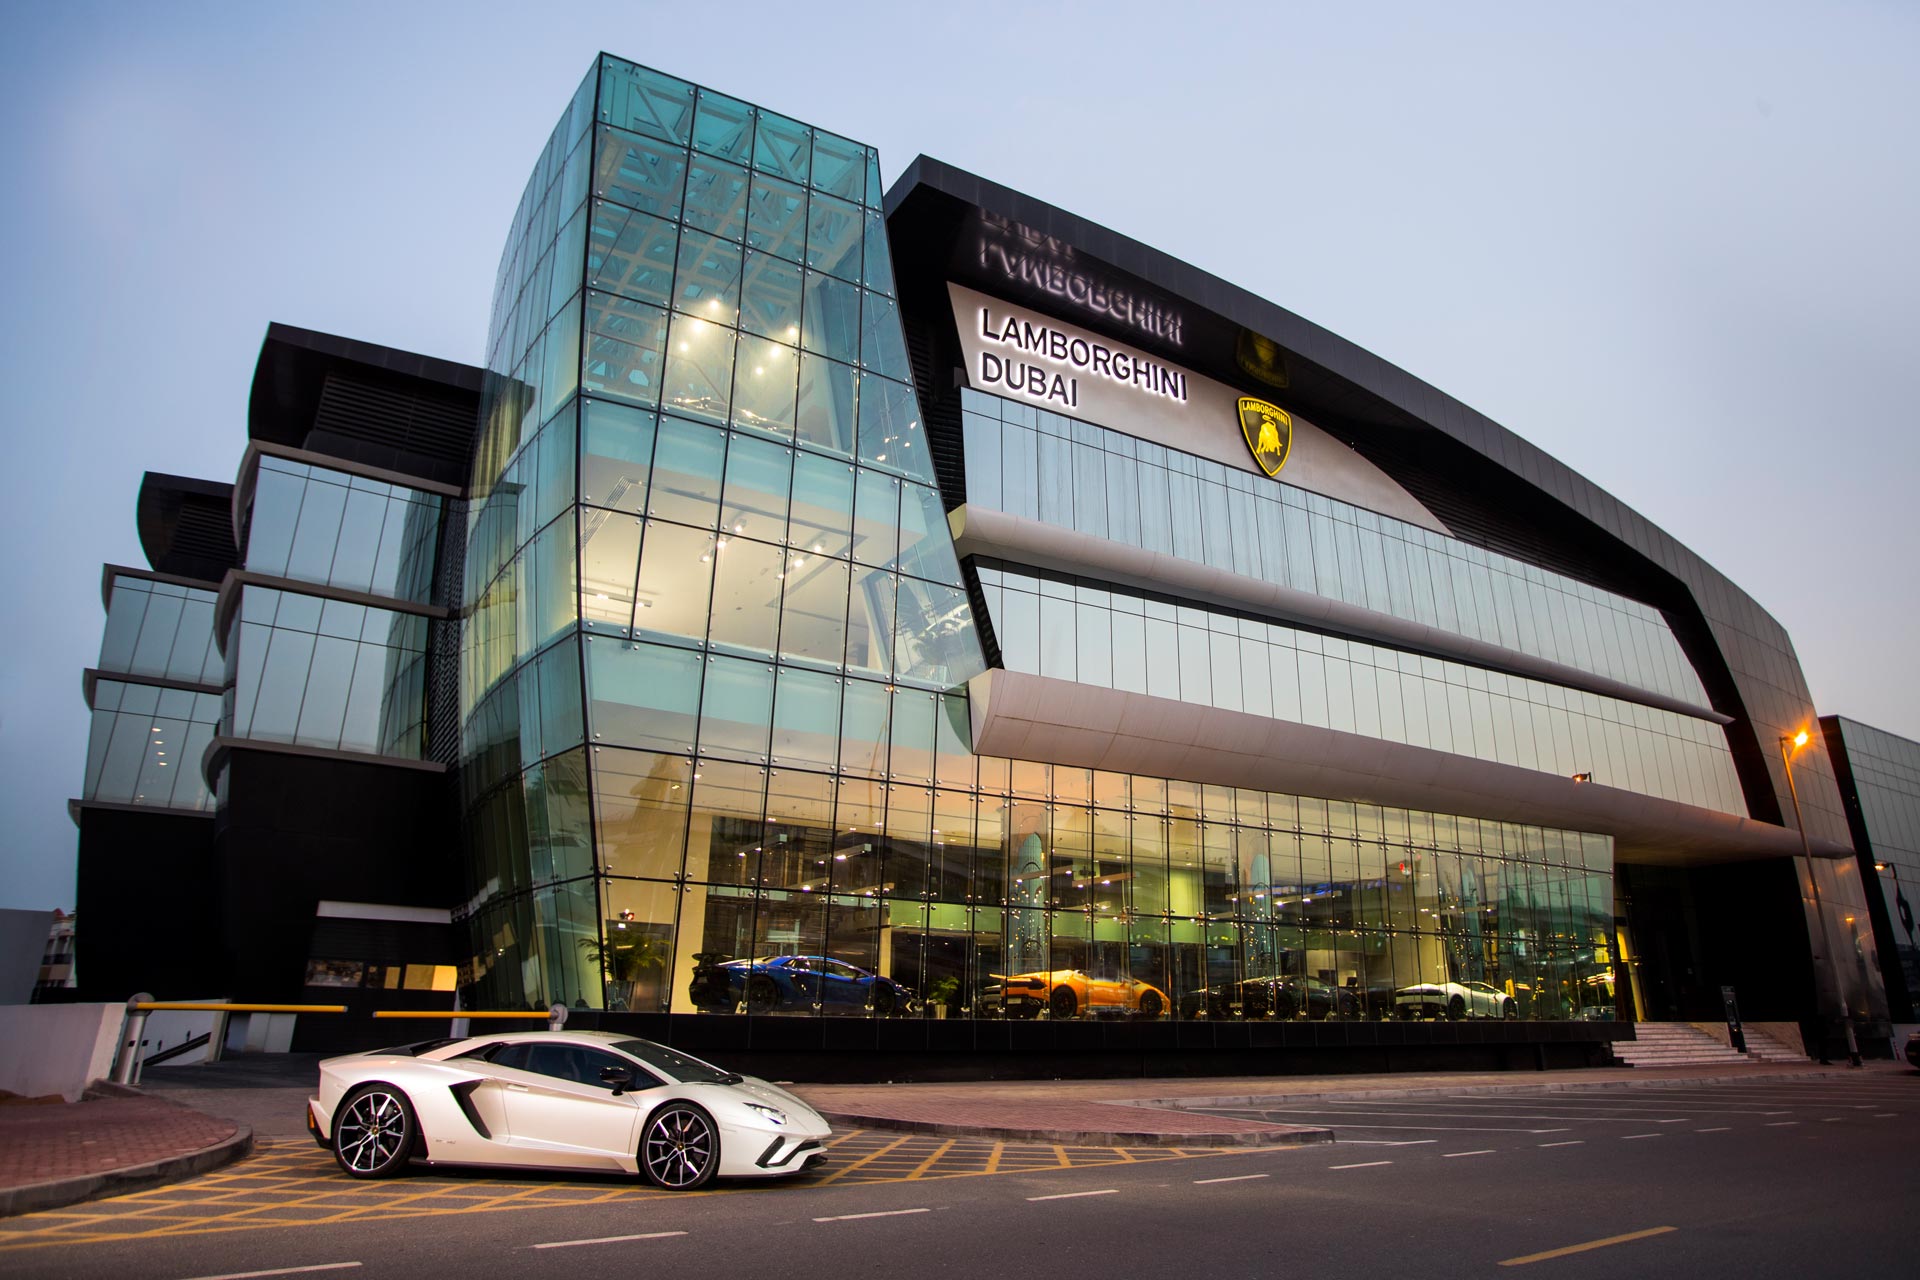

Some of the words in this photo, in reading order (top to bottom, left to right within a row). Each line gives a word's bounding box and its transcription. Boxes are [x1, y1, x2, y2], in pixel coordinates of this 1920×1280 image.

[981, 351, 1078, 407] DUBAI
[982, 307, 1188, 401] LAMBORGHINI
[1242, 401, 1288, 425] LAMBORGHINI
